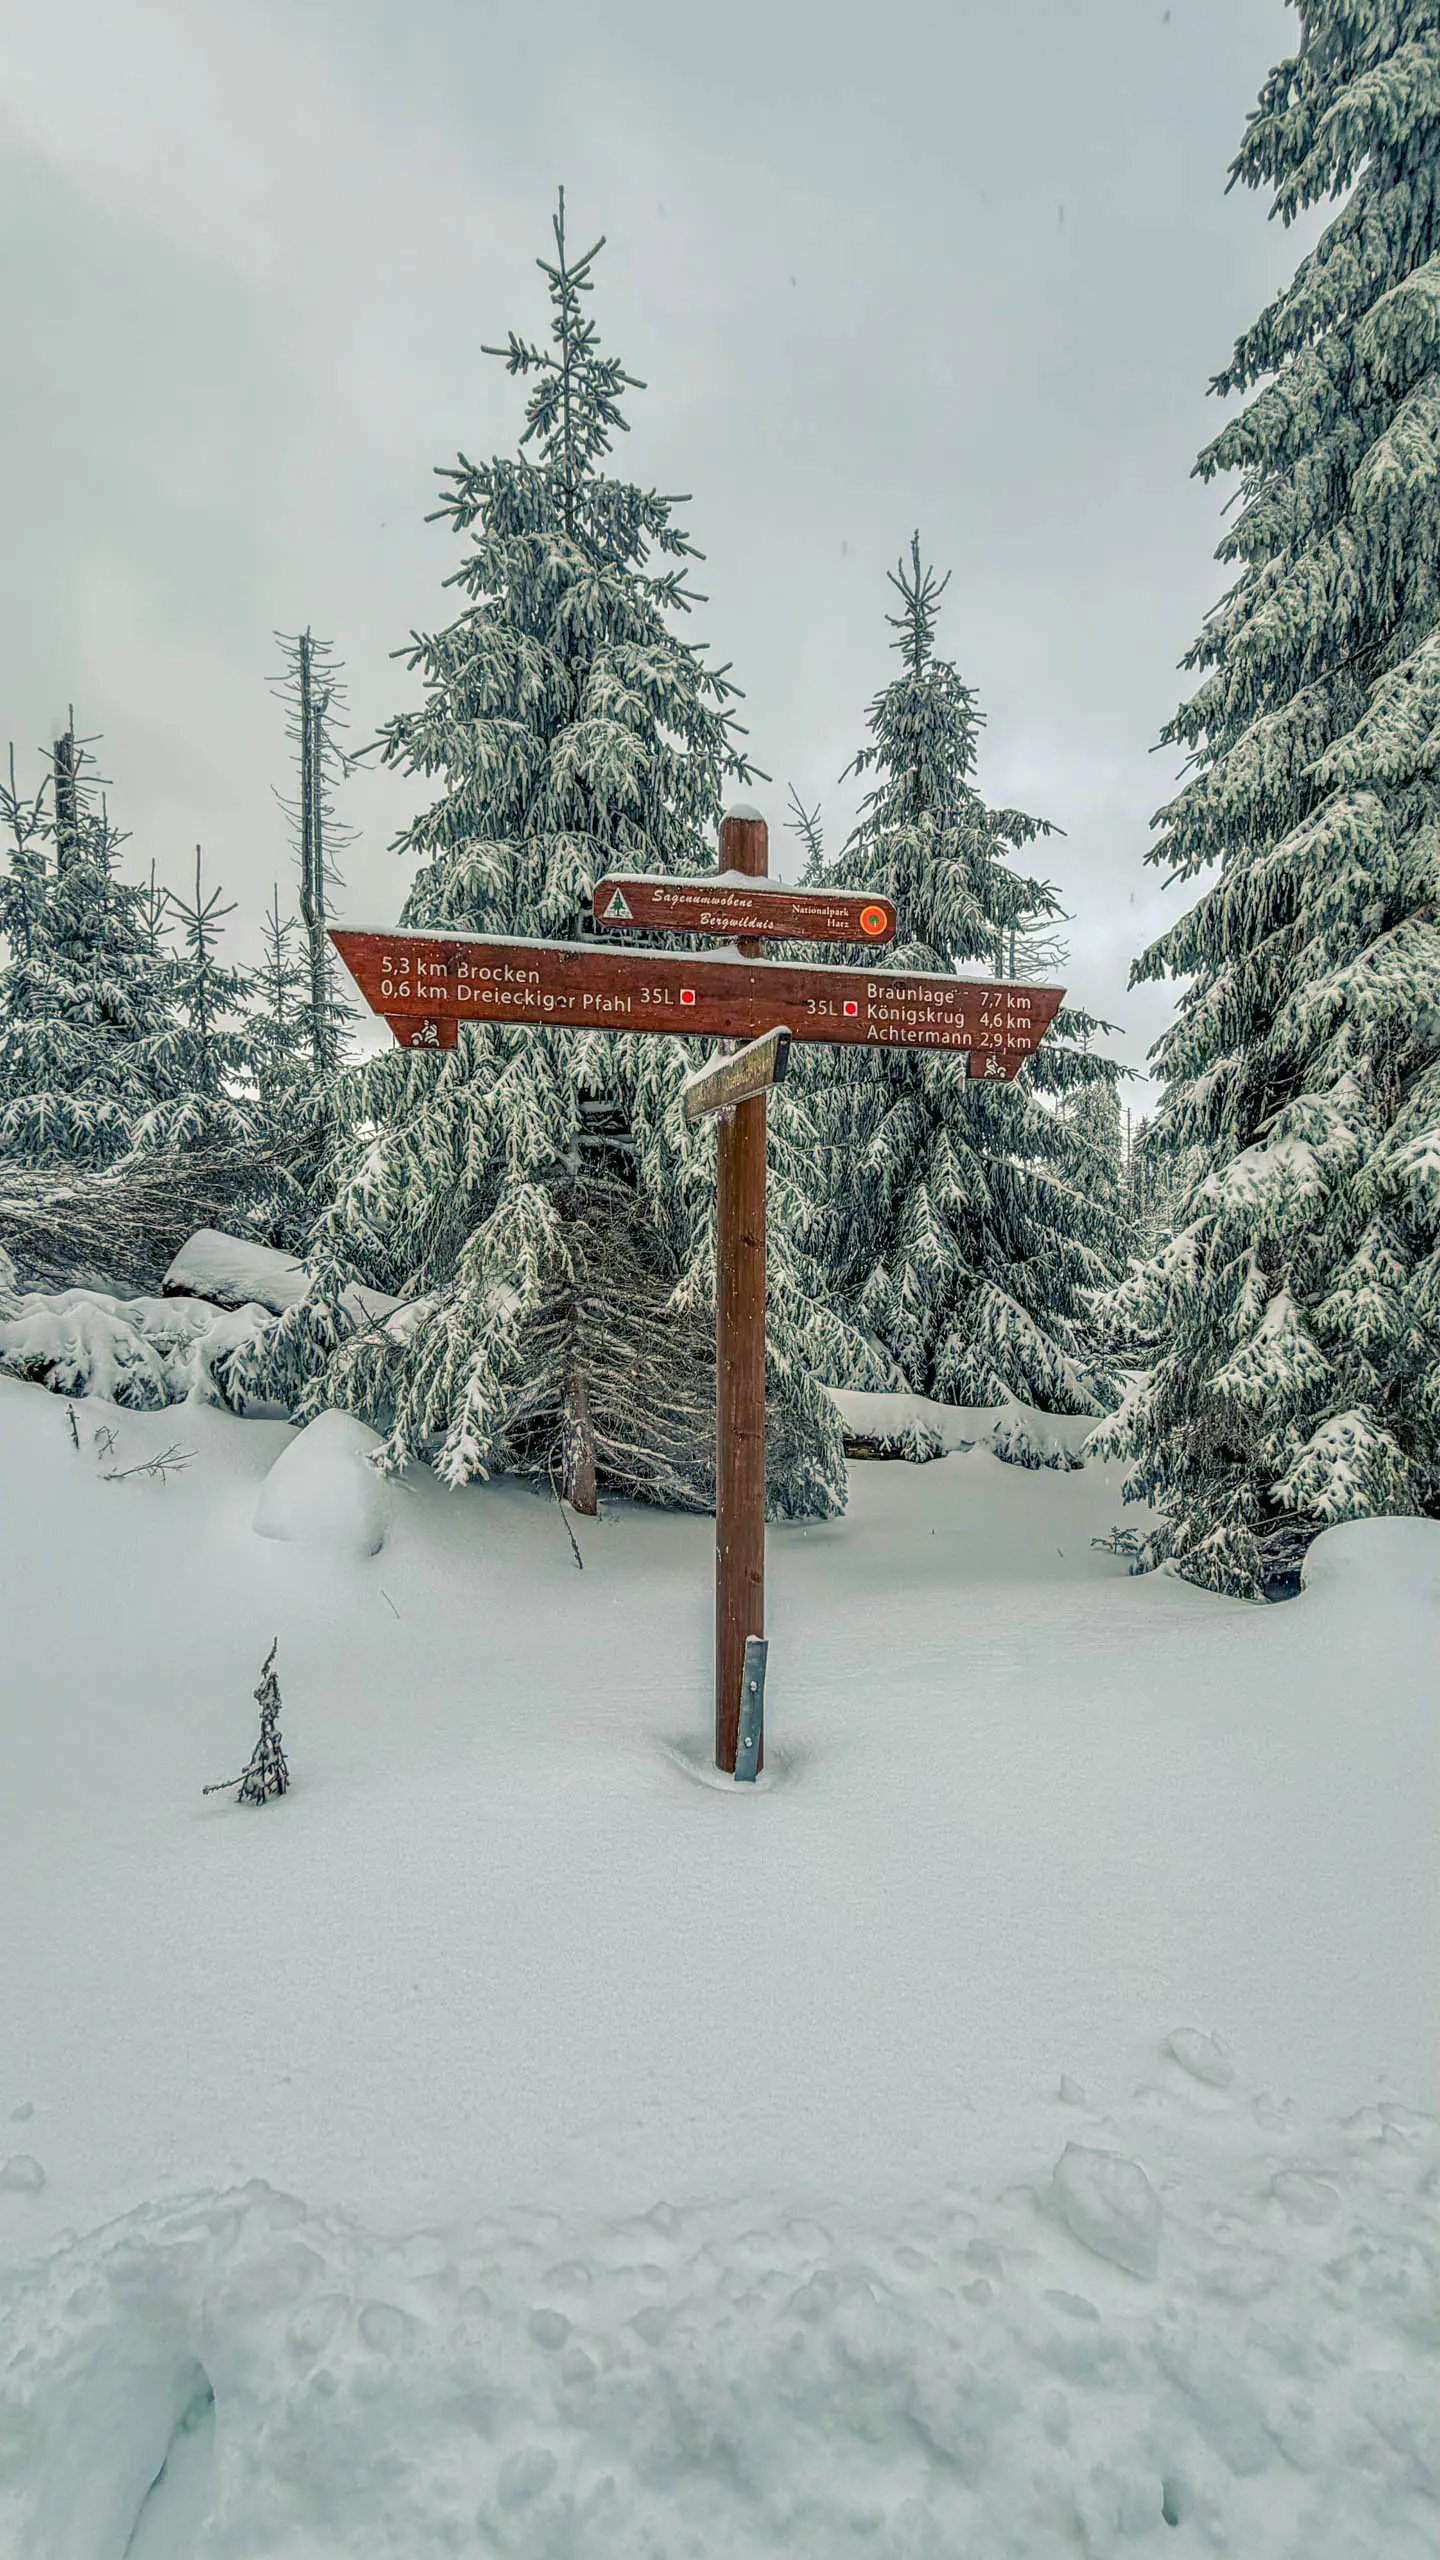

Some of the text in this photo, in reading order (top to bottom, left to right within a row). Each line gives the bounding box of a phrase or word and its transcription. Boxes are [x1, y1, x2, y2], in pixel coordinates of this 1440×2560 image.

[651, 889, 753, 909] Sagenumwobene
[792, 904, 849, 917] Nationalpark
[700, 912, 774, 930] Bergwildnis
[827, 918, 849, 928] Harz
[381, 956, 540, 984] 5,3 km Brocken
[381, 979, 632, 1013] 0,6 km Dreieckiger Pfahl
[640, 988, 674, 1005] 35L
[867, 983, 1031, 1009] Braunlage 7,7 km
[807, 1000, 838, 1016] 35L
[867, 1003, 1031, 1029] Königskrug 4,6 km
[867, 1025, 1031, 1049] Achtermann 2,9 km
